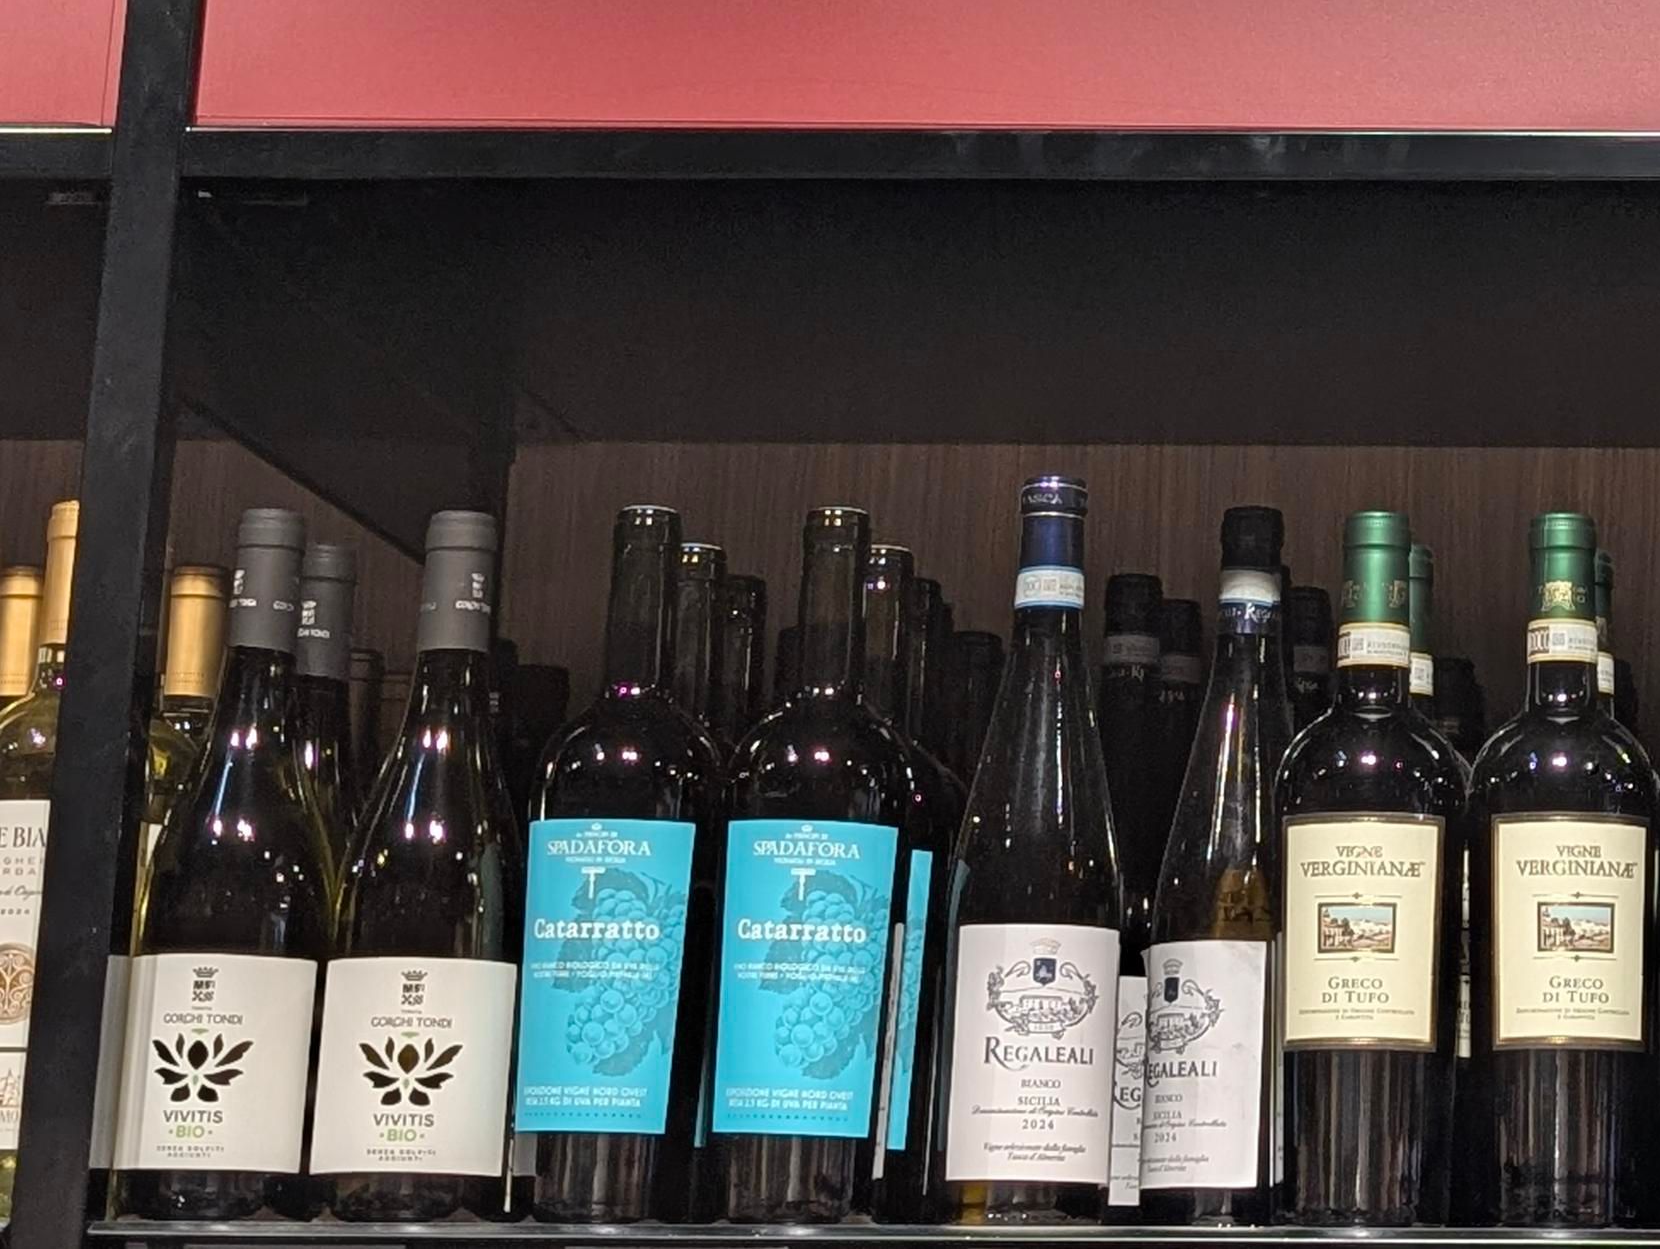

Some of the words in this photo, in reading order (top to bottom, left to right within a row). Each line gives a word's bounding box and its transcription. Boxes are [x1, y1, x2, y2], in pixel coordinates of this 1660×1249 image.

[547, 838, 651, 856] SPADAFORA
[753, 839, 860, 859] SPADAFORA
[1556, 845, 1602, 858] VIGNE
[534, 918, 660, 940] Catarratto
[738, 918, 866, 943] Catarratto
[1328, 976, 1383, 990] GRECO
[1549, 975, 1604, 990] GRECO
[1322, 992, 1338, 1003] DI
[1345, 990, 1390, 1004] TUFO
[1542, 992, 1559, 1003] DI
[1567, 990, 1609, 1004] TUFO
[984, 1036, 1094, 1071] REGALEALI
[1144, 1056, 1217, 1088] EGALEALI
[1021, 1079, 1061, 1089] BIANCO
[1018, 1096, 1061, 1106] SICILIA
[163, 1110, 223, 1124] VIVITIS
[373, 1113, 434, 1127] VIVITIS
[176, 1125, 205, 1138] BIO
[1022, 1119, 1054, 1130] 2024
[387, 1129, 417, 1142] BIO
